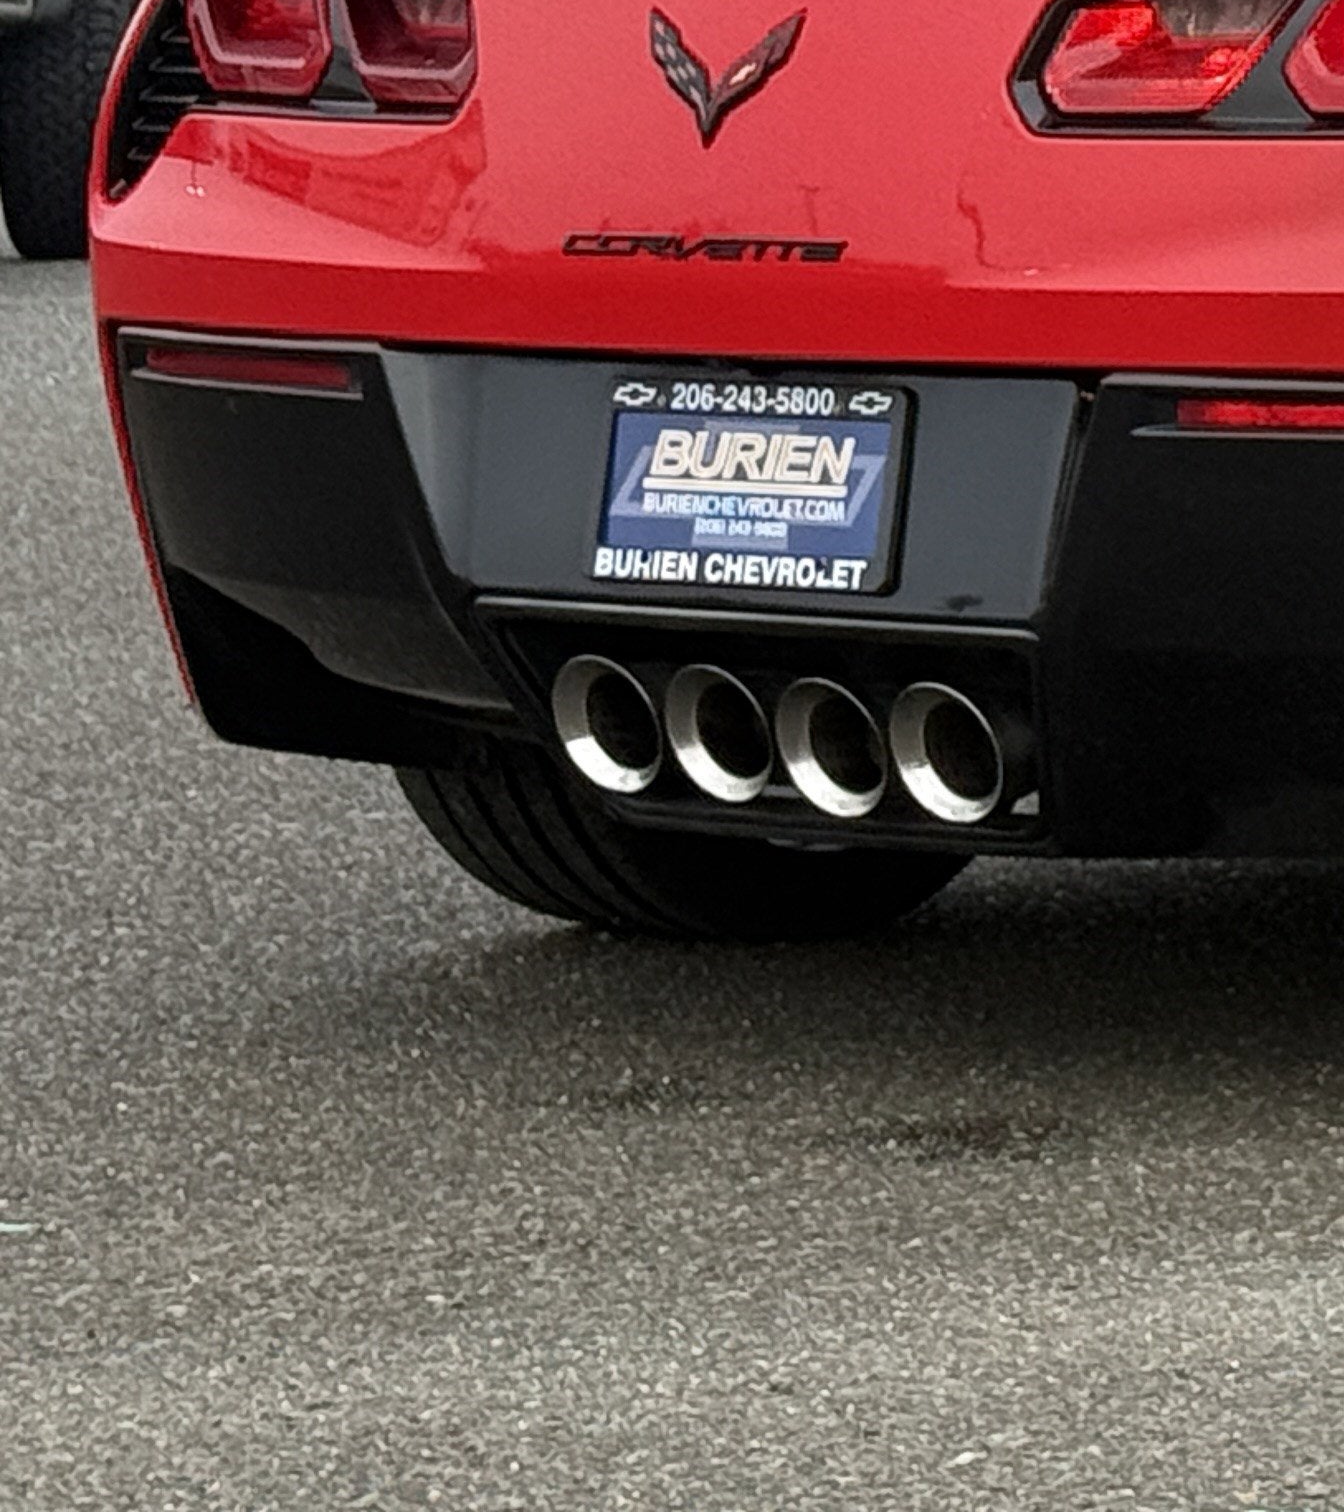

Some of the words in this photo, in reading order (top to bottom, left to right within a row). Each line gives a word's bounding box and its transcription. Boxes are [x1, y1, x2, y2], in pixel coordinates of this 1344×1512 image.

[562, 234, 848, 263] CORVETTE
[670, 382, 836, 416] 206-243-5800
[649, 429, 857, 484] BURIEN
[593, 546, 699, 582] BURIEN
[703, 552, 868, 590] CHEVROLET
